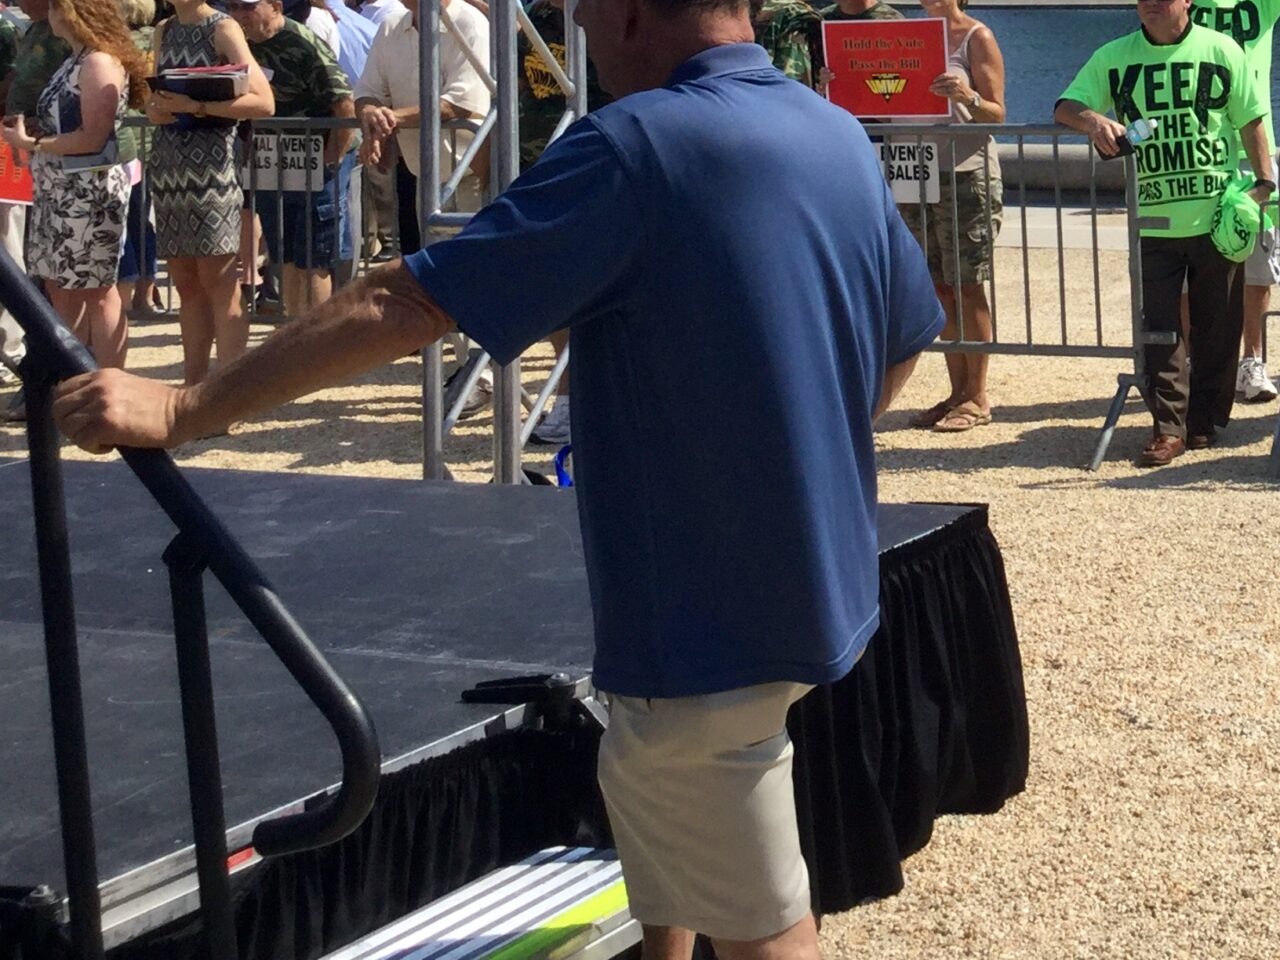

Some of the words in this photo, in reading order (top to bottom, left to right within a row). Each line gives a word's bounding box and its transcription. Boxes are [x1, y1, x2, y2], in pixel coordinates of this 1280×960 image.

[1187, 0, 1261, 55] EEP
[1108, 61, 1231, 135] KEEP
[1147, 112, 1194, 140] THE
[278, 136, 322, 153] VENS
[881, 144, 934, 162] EVENS
[1133, 137, 1229, 174] ROMISE!
[888, 164, 931, 181] SALES
[1165, 176, 1199, 198] THE
